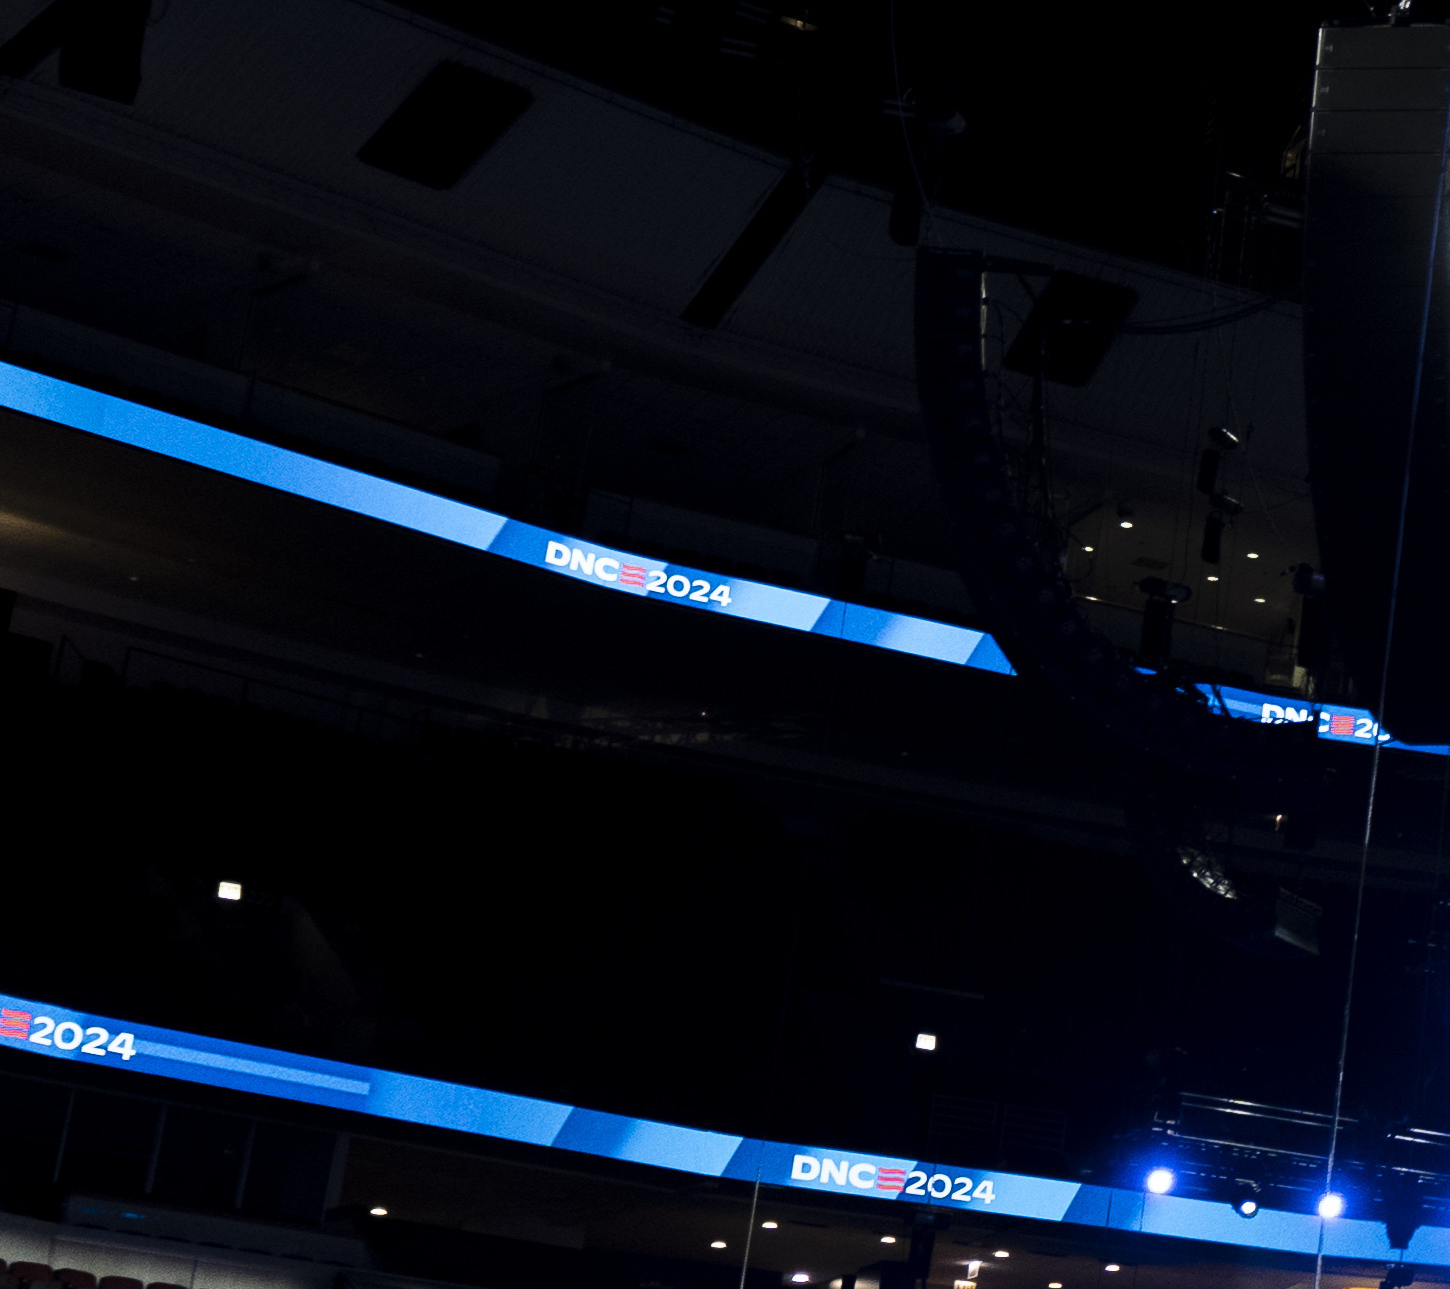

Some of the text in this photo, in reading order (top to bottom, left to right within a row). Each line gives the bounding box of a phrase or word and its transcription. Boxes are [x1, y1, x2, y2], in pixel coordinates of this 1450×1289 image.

[545, 540, 732, 607] DNC 2024
[29, 1016, 137, 1061] 2024
[791, 1154, 996, 1205] DNC 2024
